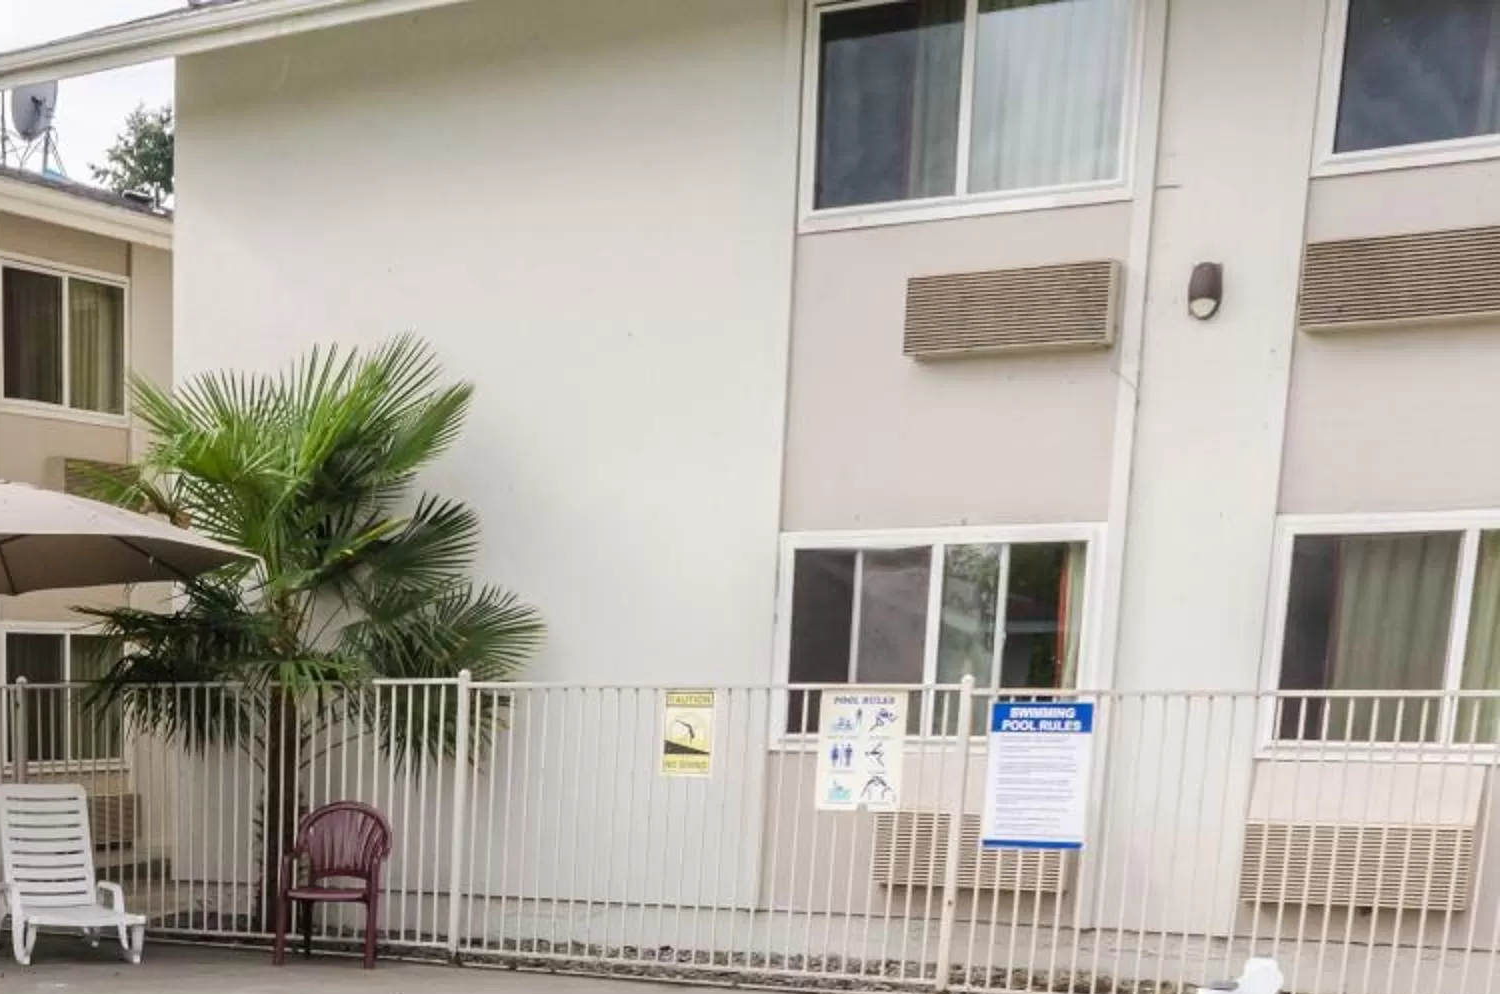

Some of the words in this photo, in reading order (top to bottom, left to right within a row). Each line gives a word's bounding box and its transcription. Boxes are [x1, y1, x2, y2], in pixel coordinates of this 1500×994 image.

[833, 696, 859, 705] POOL
[862, 696, 896, 705] RULES
[1009, 707, 1076, 719] SWIMMING
[1001, 719, 1038, 731] POOL
[1040, 719, 1082, 732] RULES
